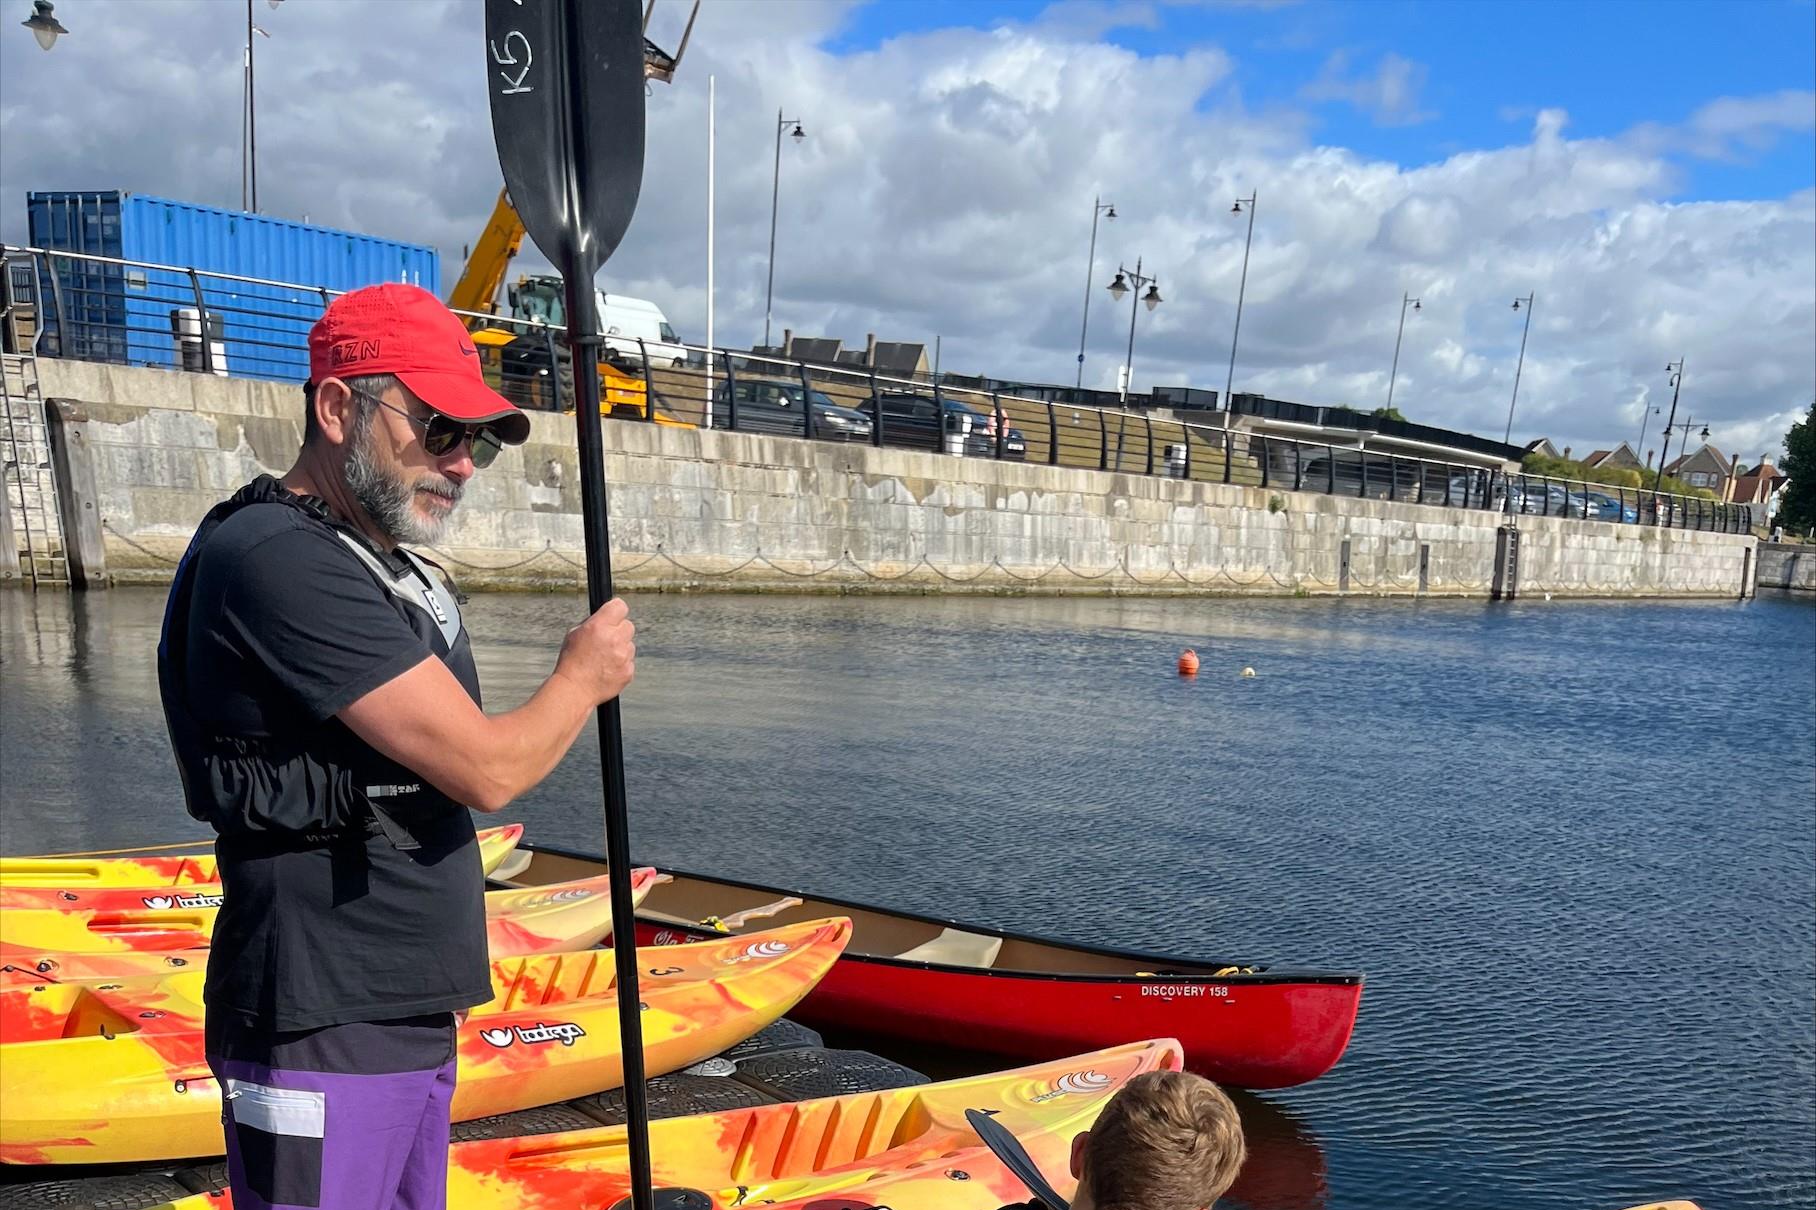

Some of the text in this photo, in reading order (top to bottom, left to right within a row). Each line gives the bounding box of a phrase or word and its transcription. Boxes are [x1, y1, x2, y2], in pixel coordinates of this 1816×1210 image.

[491, 30, 534, 95] K5
[175, 894, 224, 908] toote
[1141, 986, 1228, 997] DISCOVERY 158
